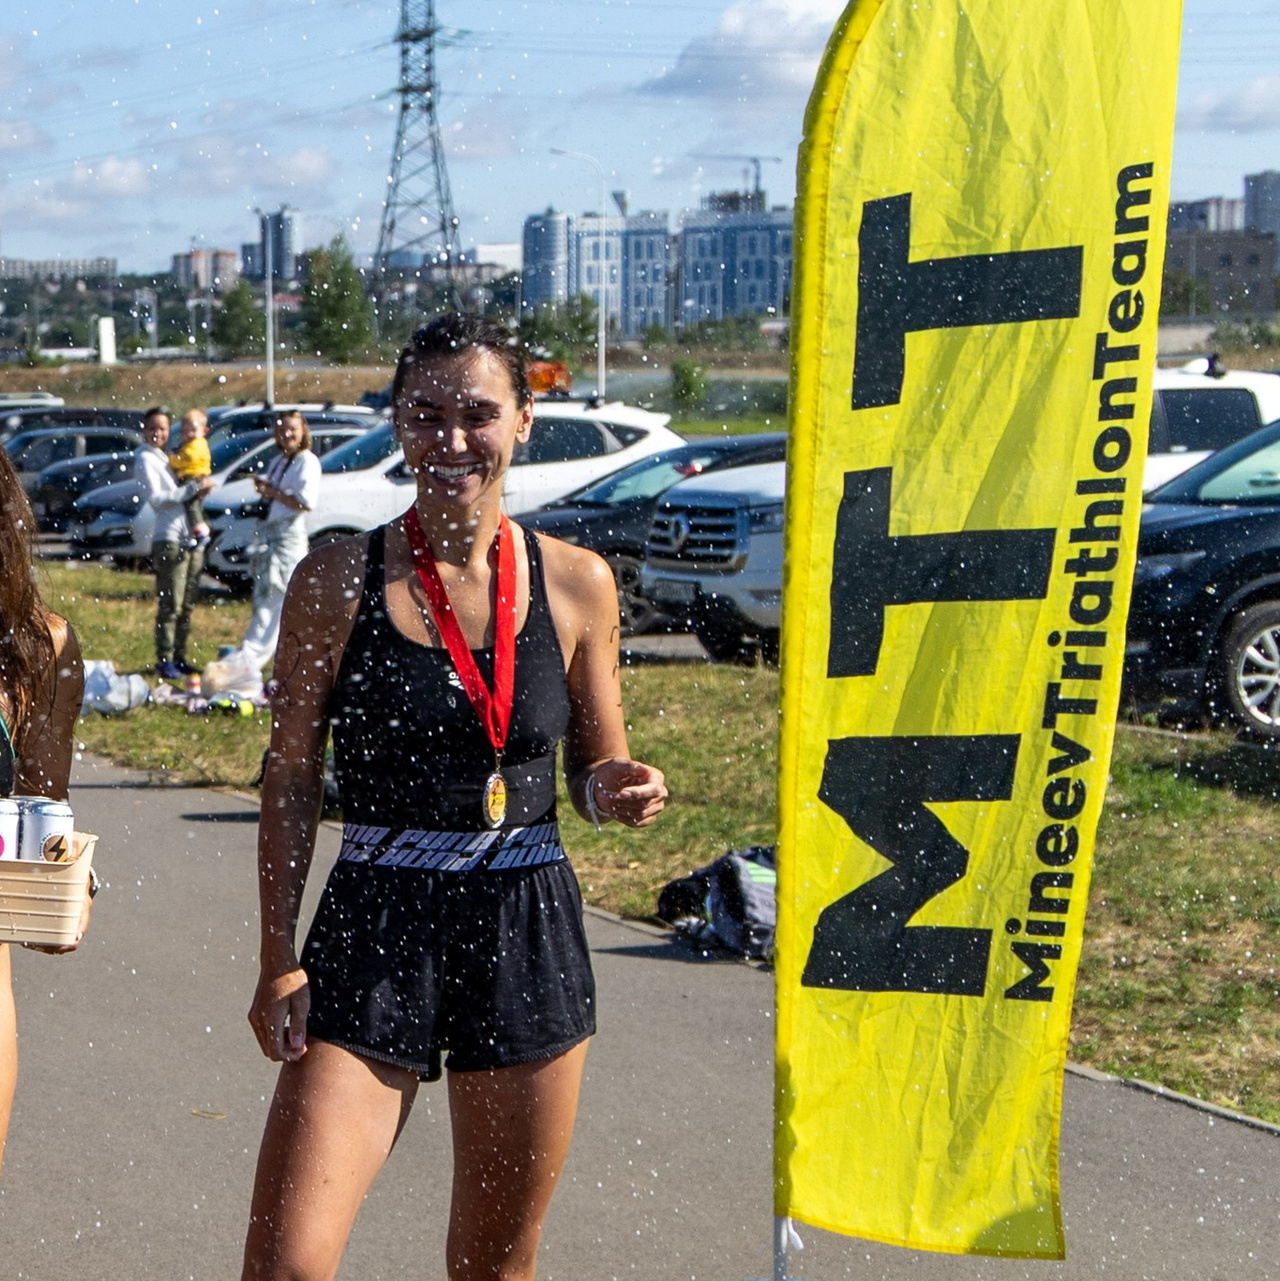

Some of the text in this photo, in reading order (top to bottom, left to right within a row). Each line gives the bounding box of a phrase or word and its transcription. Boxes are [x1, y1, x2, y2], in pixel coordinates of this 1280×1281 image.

[392, 829, 500, 851] PUMA
[802, 193, 1084, 997] MTT
[1004, 162, 1155, 1002] MineevTriathlonTeam
